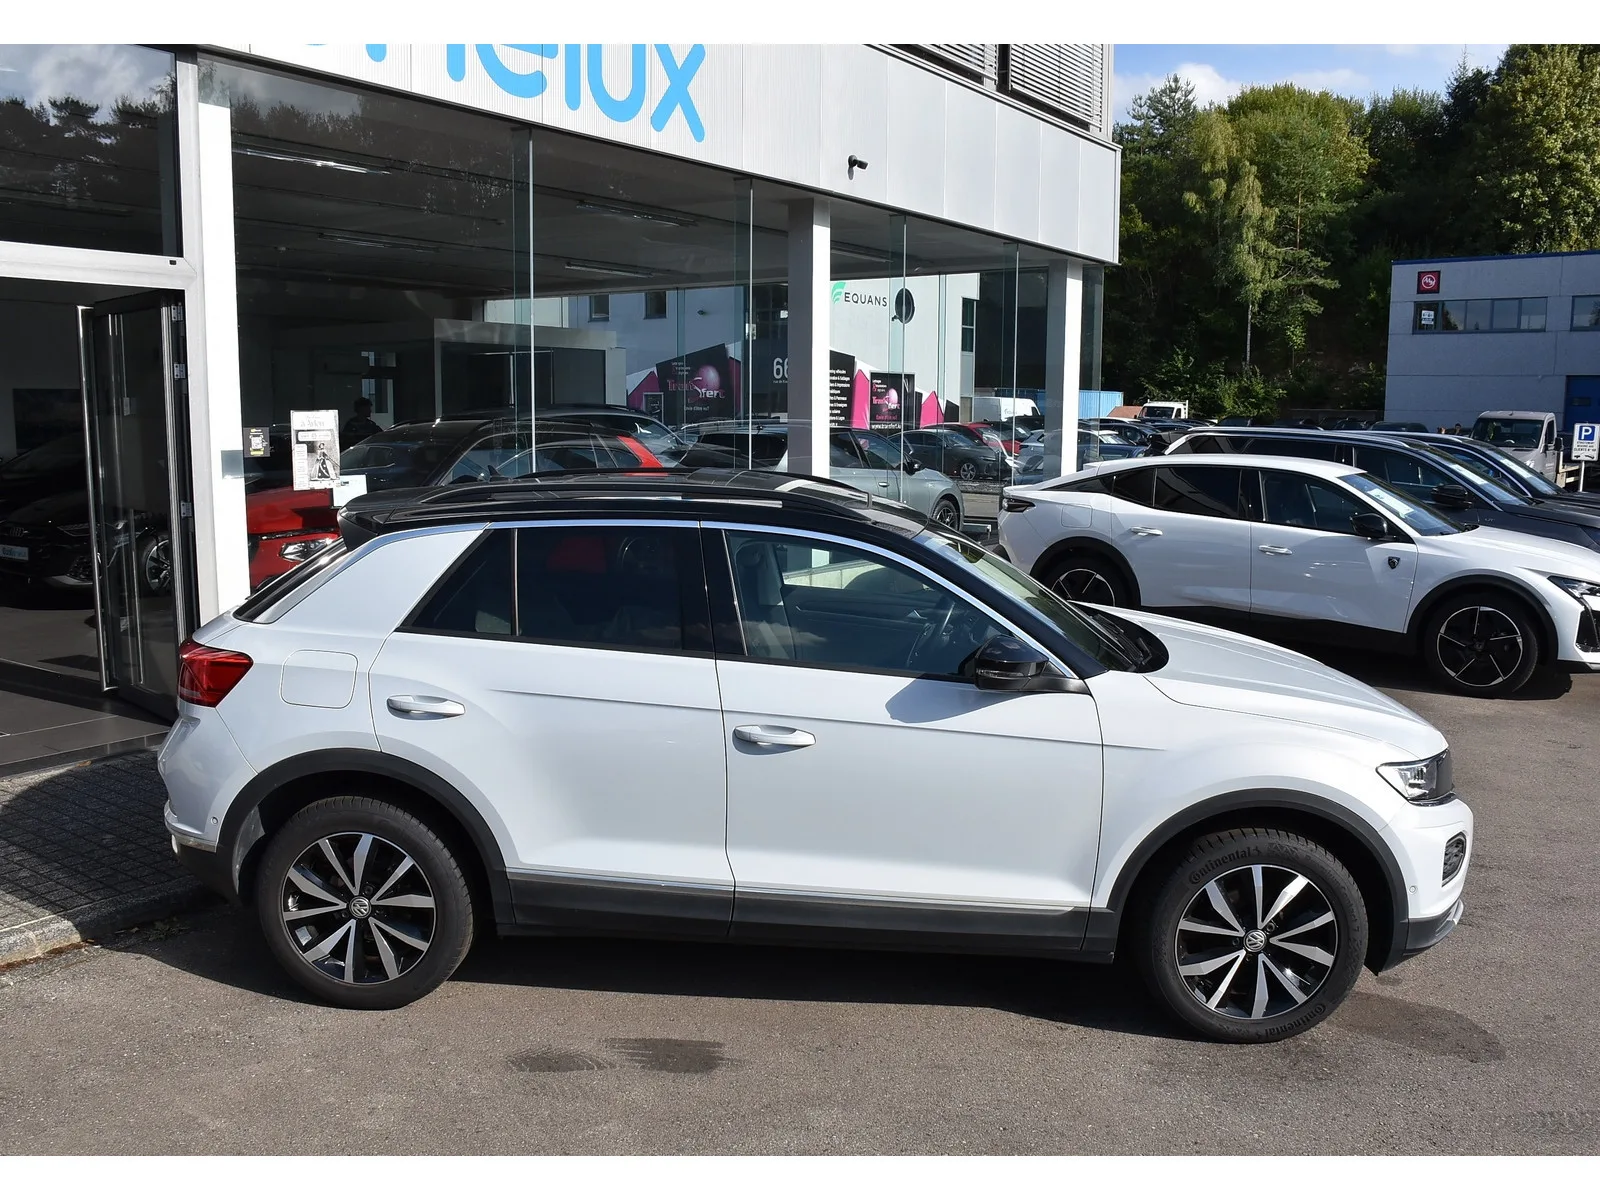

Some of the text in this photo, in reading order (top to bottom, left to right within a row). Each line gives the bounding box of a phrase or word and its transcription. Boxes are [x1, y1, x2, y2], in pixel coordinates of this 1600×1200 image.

[844, 292, 888, 307] EQUANS
[1581, 426, 1592, 440] P
[1189, 846, 1251, 884] Continental
[1264, 1003, 1326, 1039] Continental
